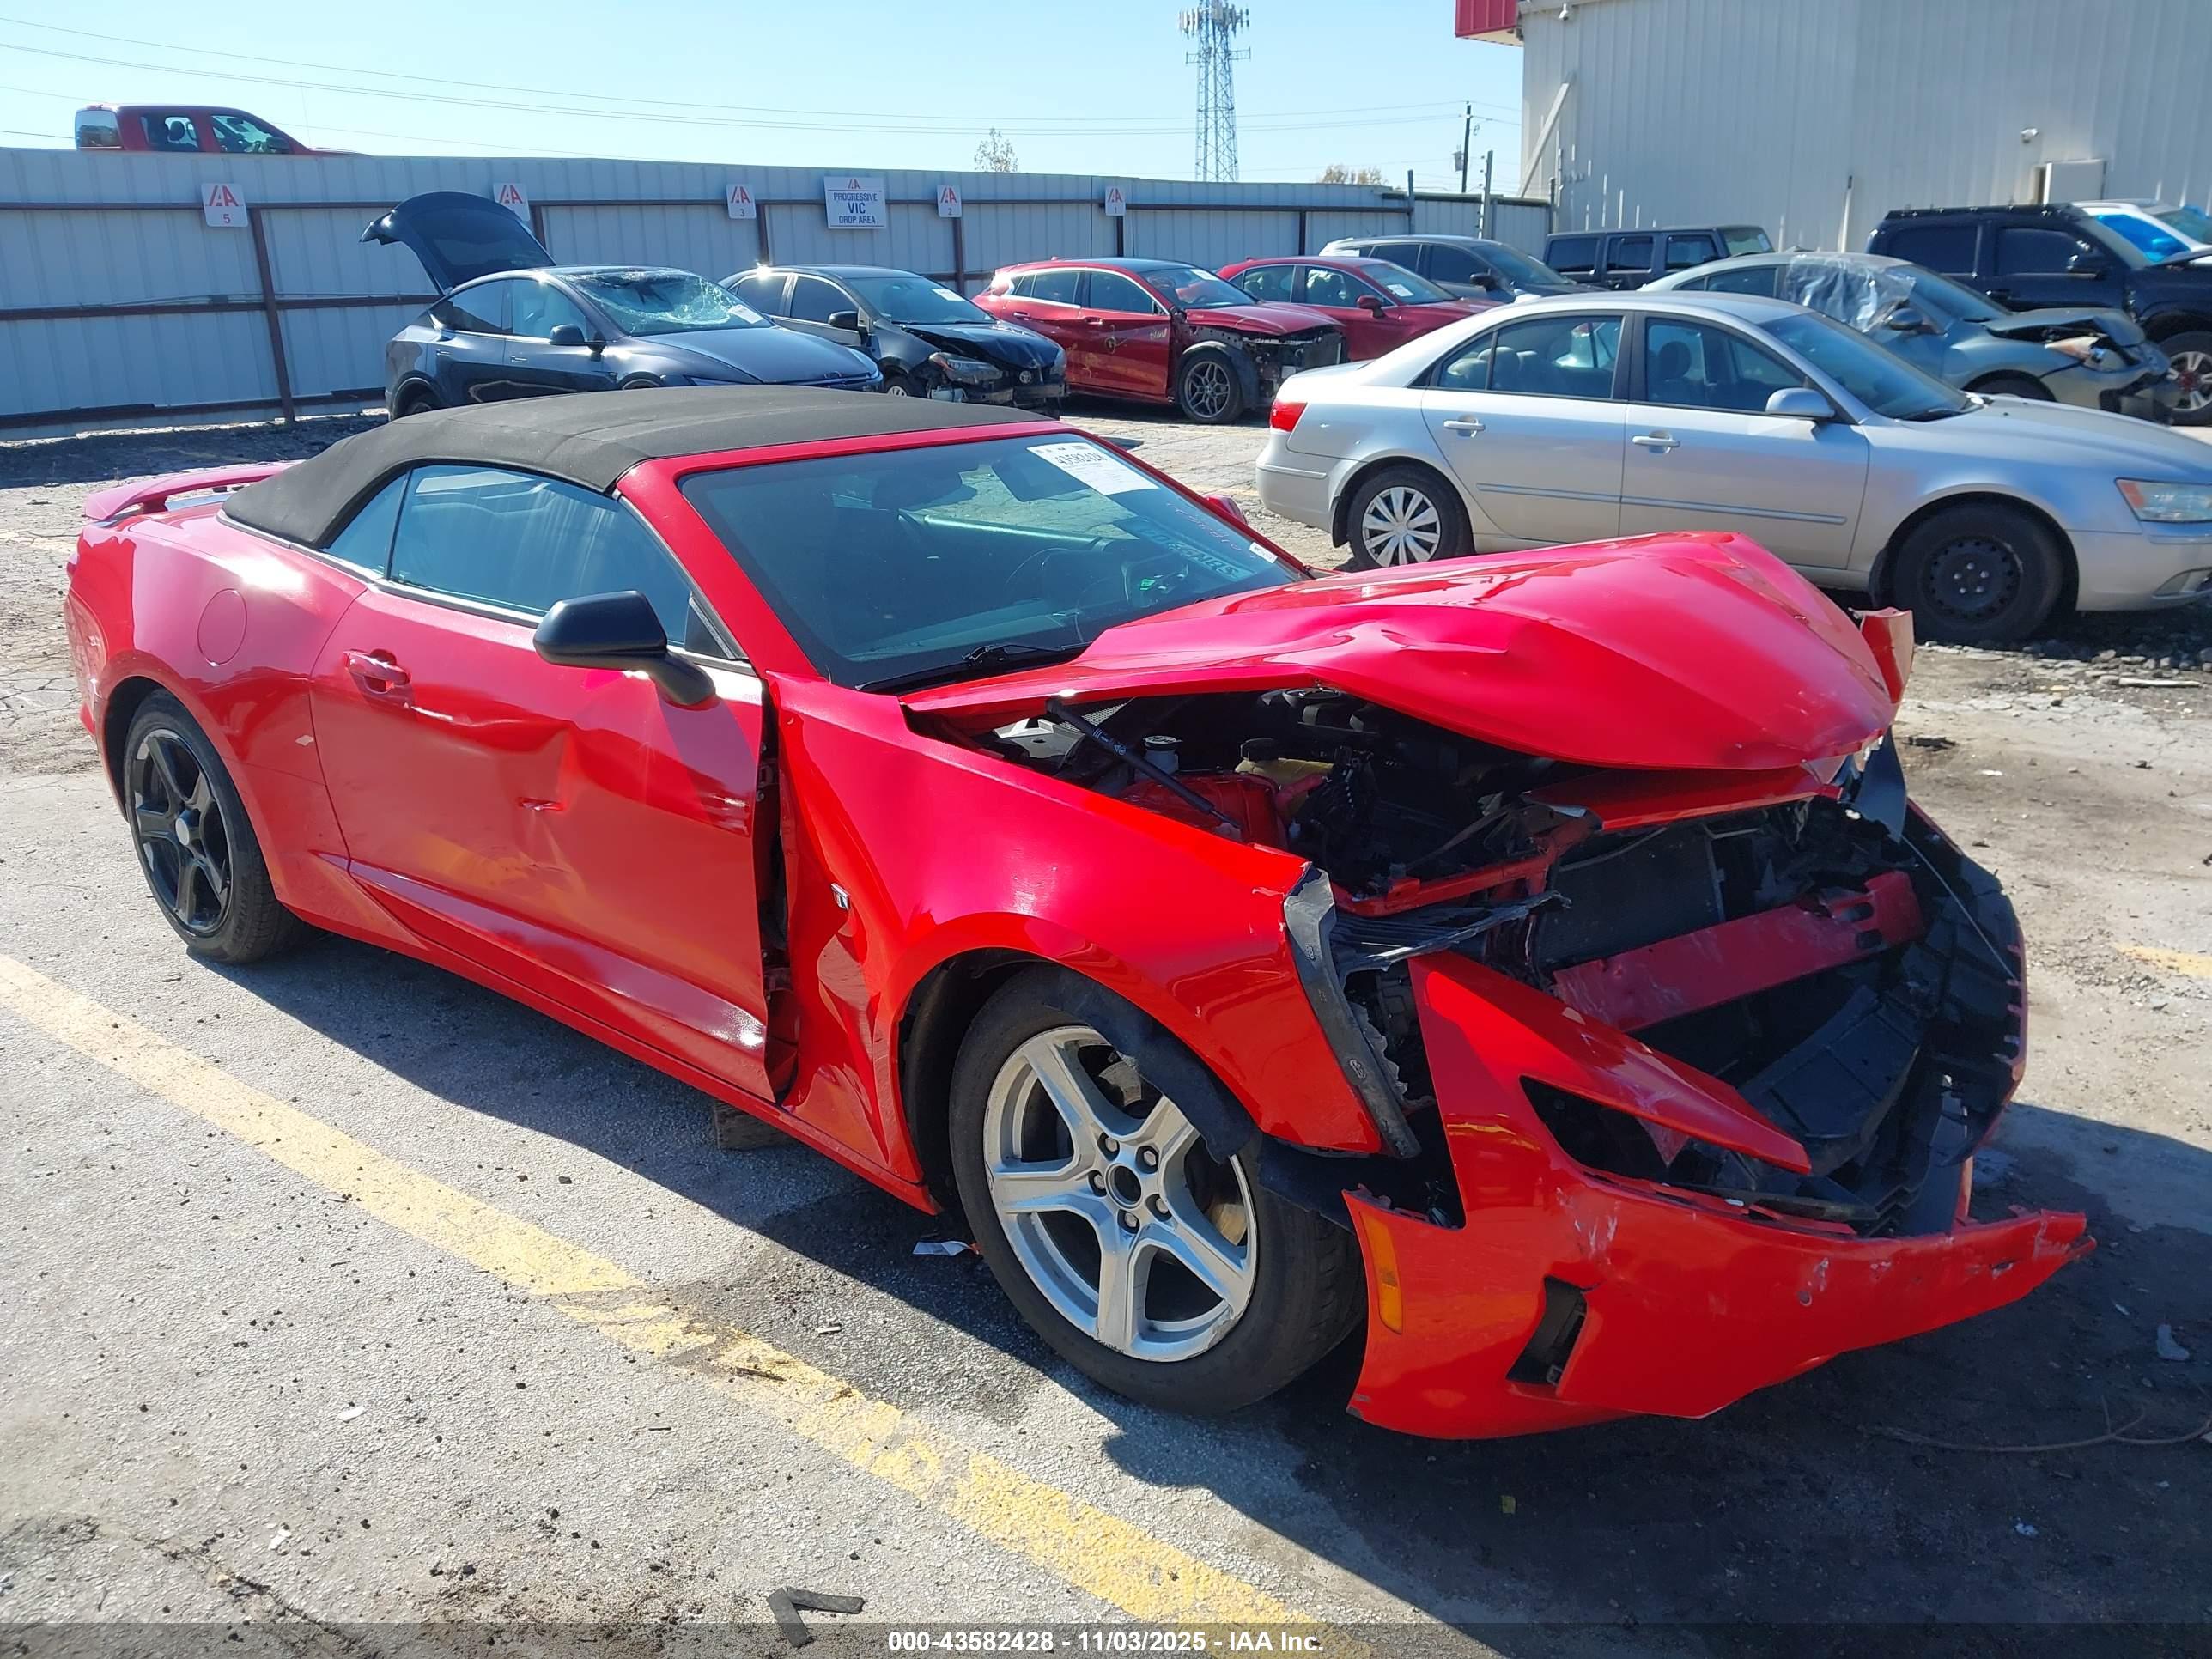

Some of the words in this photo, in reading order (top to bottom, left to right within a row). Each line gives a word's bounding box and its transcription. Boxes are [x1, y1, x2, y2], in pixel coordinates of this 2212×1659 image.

[833, 192, 878, 202] PROGRESSIVE
[739, 208, 746, 217] 3
[847, 202, 866, 214] VIC
[947, 207, 953, 216] 2
[222, 213, 231, 224] 5
[838, 215, 857, 224] DROP
[858, 215, 876, 225] AREA
